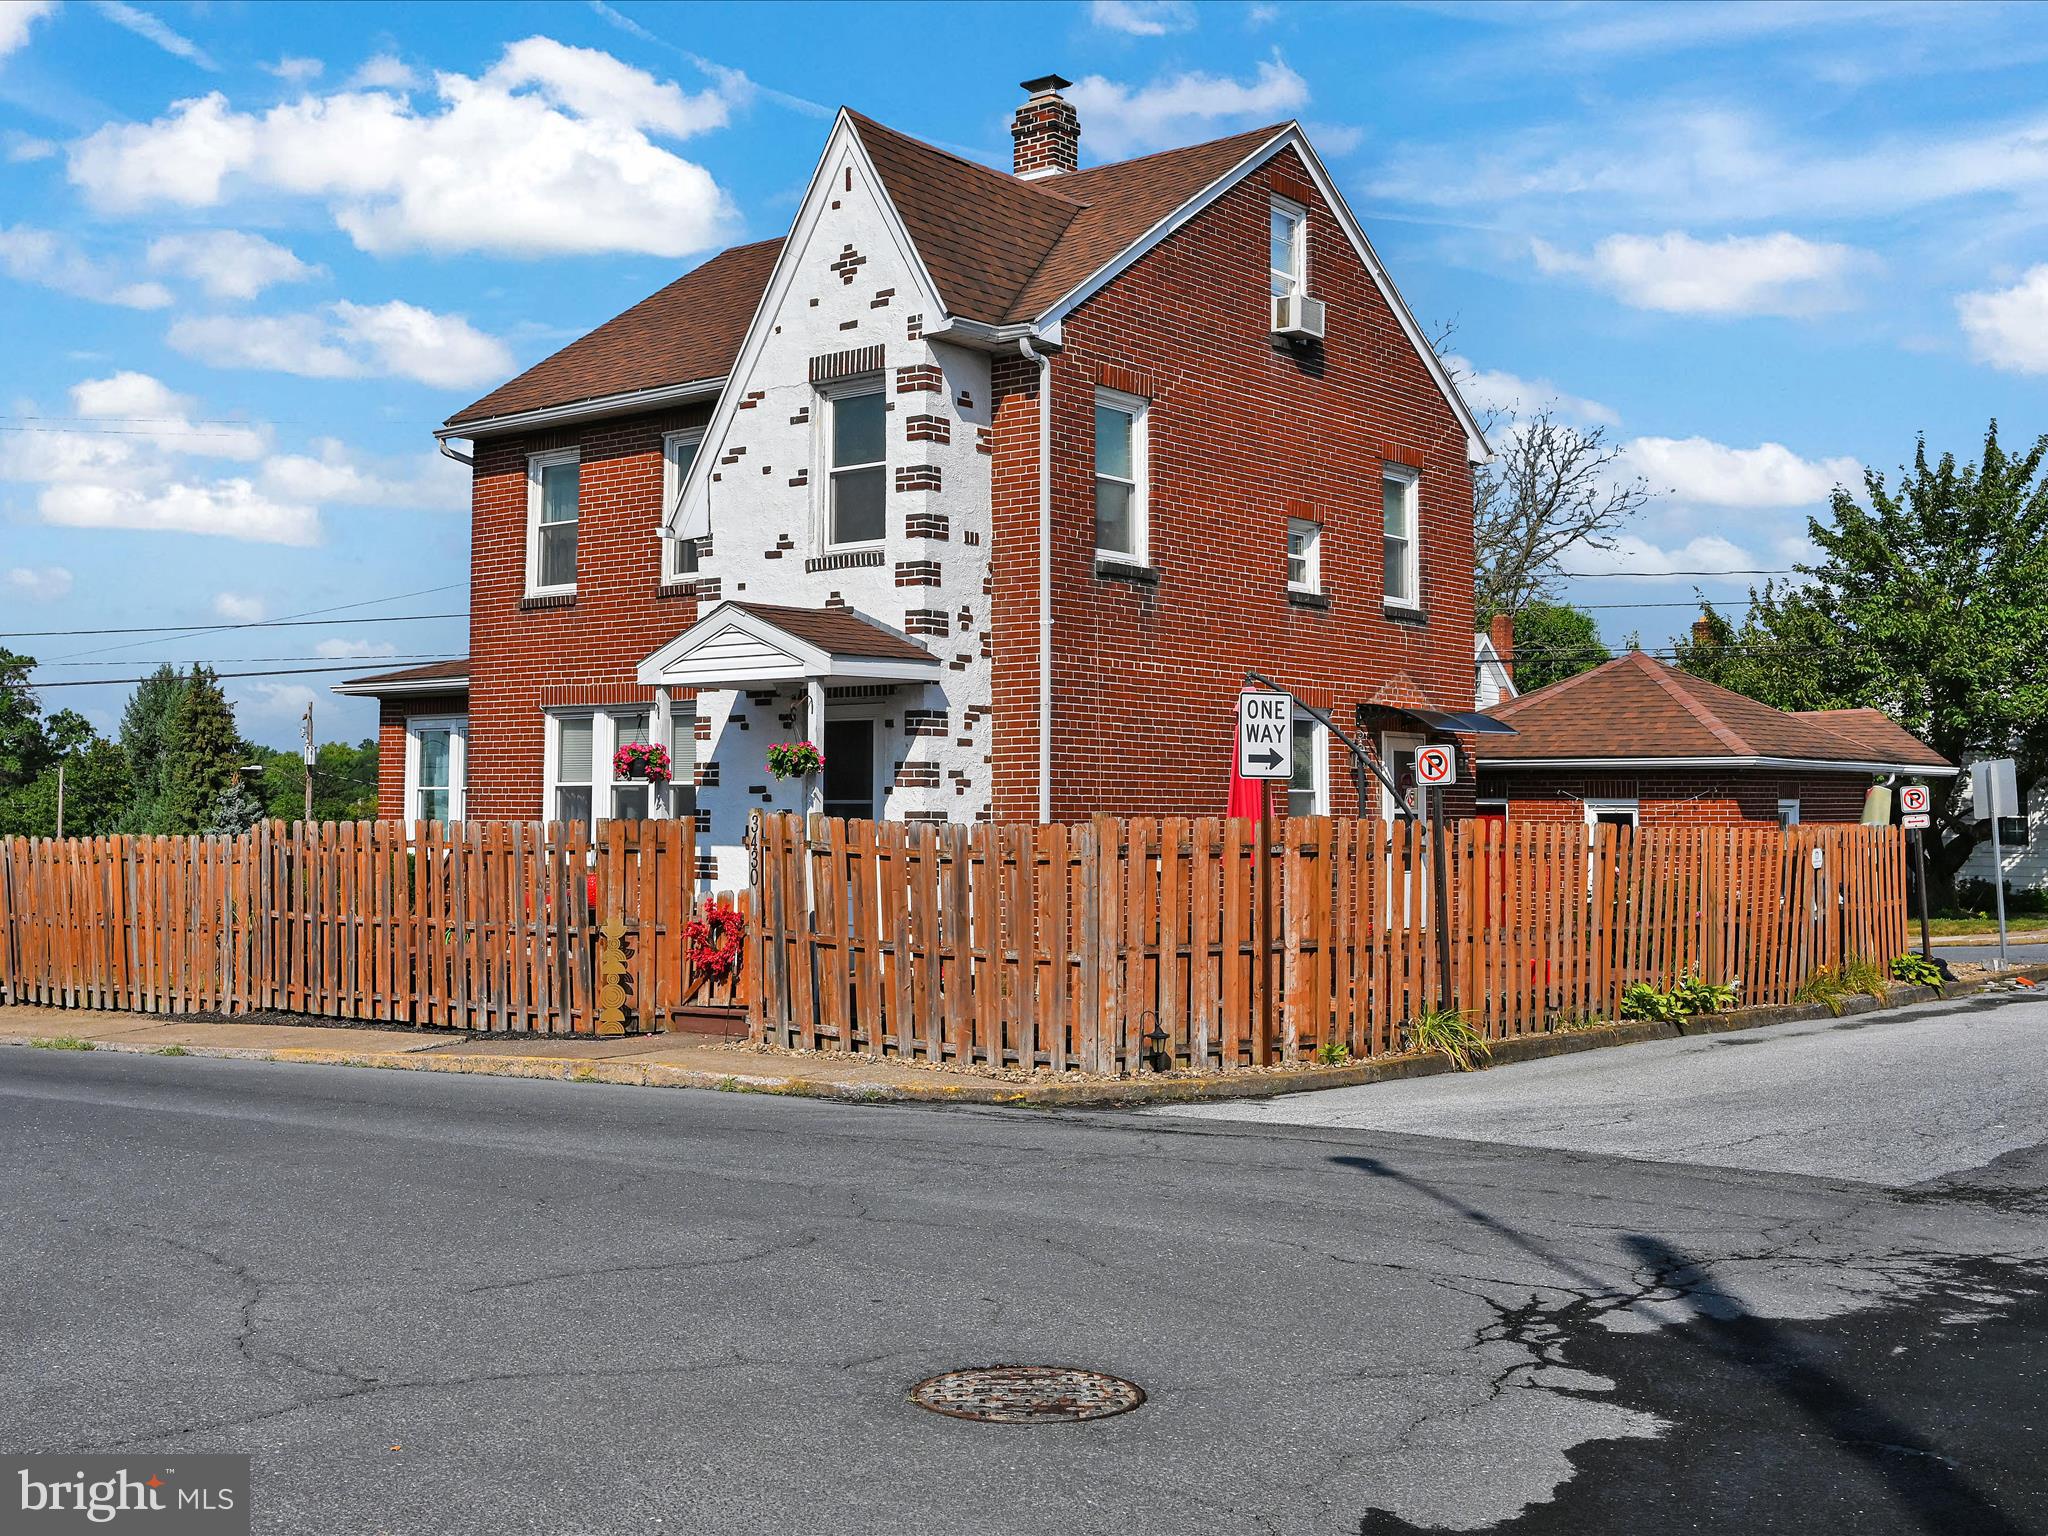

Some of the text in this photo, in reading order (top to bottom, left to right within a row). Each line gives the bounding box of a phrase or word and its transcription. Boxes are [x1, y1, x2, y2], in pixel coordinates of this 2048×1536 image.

[1247, 699, 1285, 720] ONE
[1246, 724, 1286, 744] WAY
[1427, 754, 1443, 776] P
[1909, 792, 1921, 807] P
[750, 815, 759, 886] 3430
